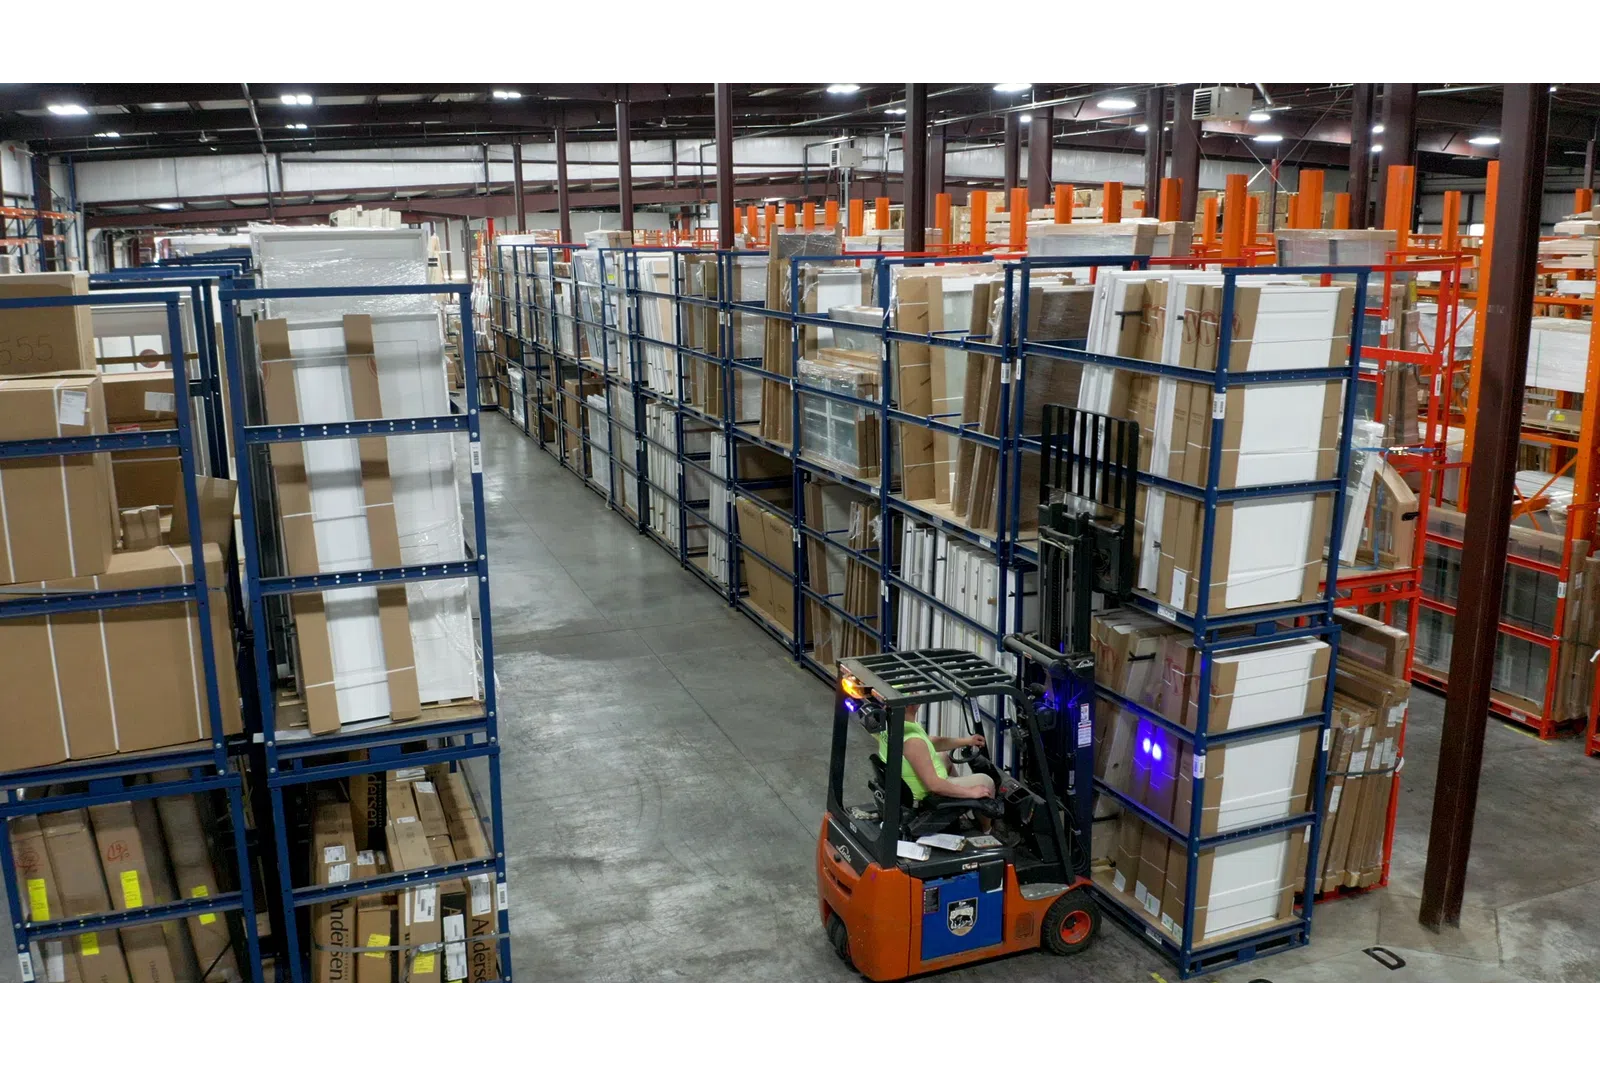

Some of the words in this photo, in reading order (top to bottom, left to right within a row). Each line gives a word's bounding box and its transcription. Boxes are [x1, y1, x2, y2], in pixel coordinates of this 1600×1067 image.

[368, 774, 382, 828] dersen
[836, 844, 852, 864] Linde
[330, 898, 349, 981] Andersen
[472, 919, 490, 984] Anderse
